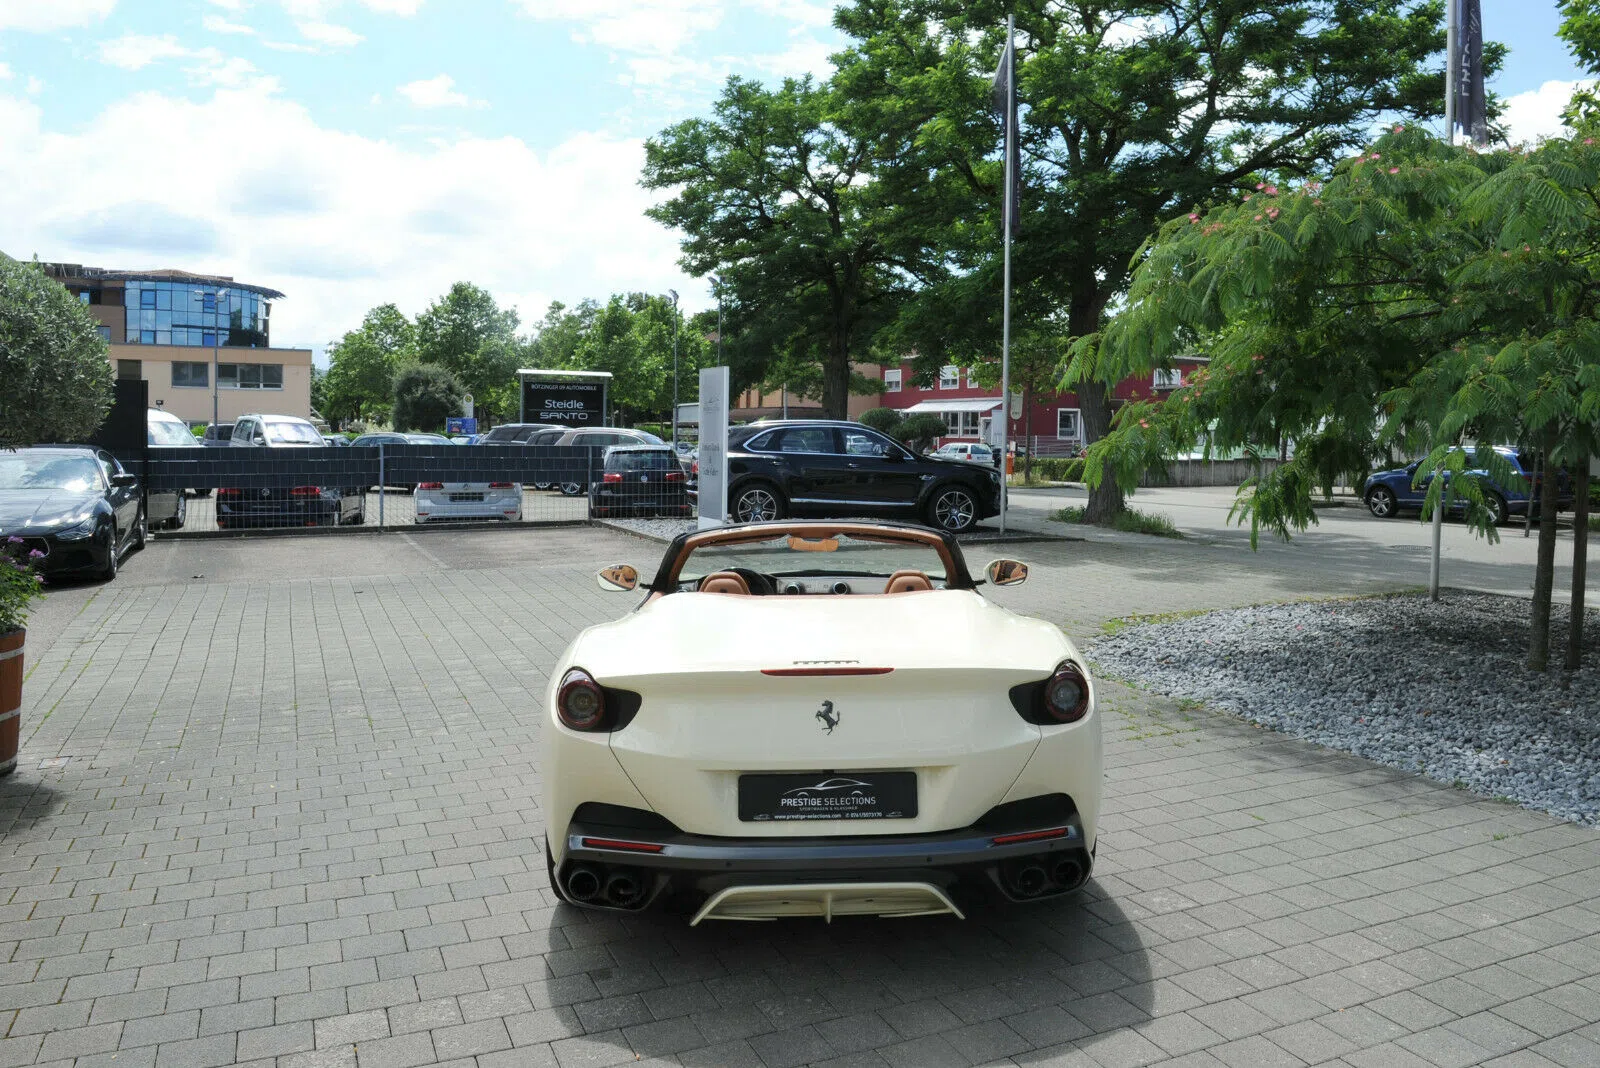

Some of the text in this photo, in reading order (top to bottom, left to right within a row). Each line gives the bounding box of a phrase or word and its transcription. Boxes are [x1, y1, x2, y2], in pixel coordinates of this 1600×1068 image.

[545, 399, 584, 409] Steidle
[540, 412, 588, 420] SANTO
[781, 796, 876, 807] PRESTIGE SELECTIONS
